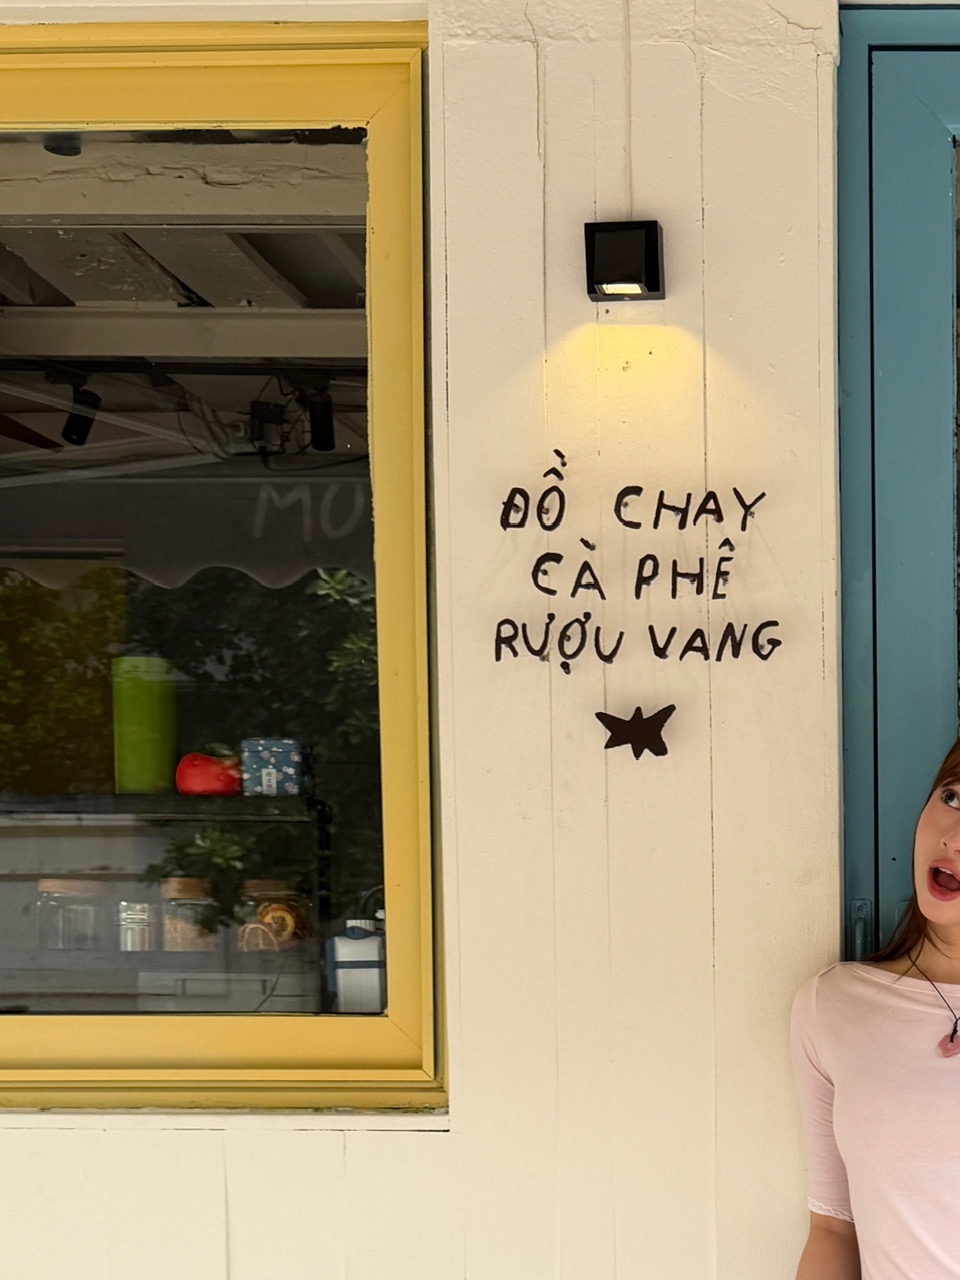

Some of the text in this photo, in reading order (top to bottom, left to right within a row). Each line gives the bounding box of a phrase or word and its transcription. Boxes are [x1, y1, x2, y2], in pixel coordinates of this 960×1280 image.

[501, 448, 767, 532] ĐỒ CHAY
[531, 537, 736, 601] CÀ PHÊ
[494, 611, 783, 675] RƯỢU VANG
